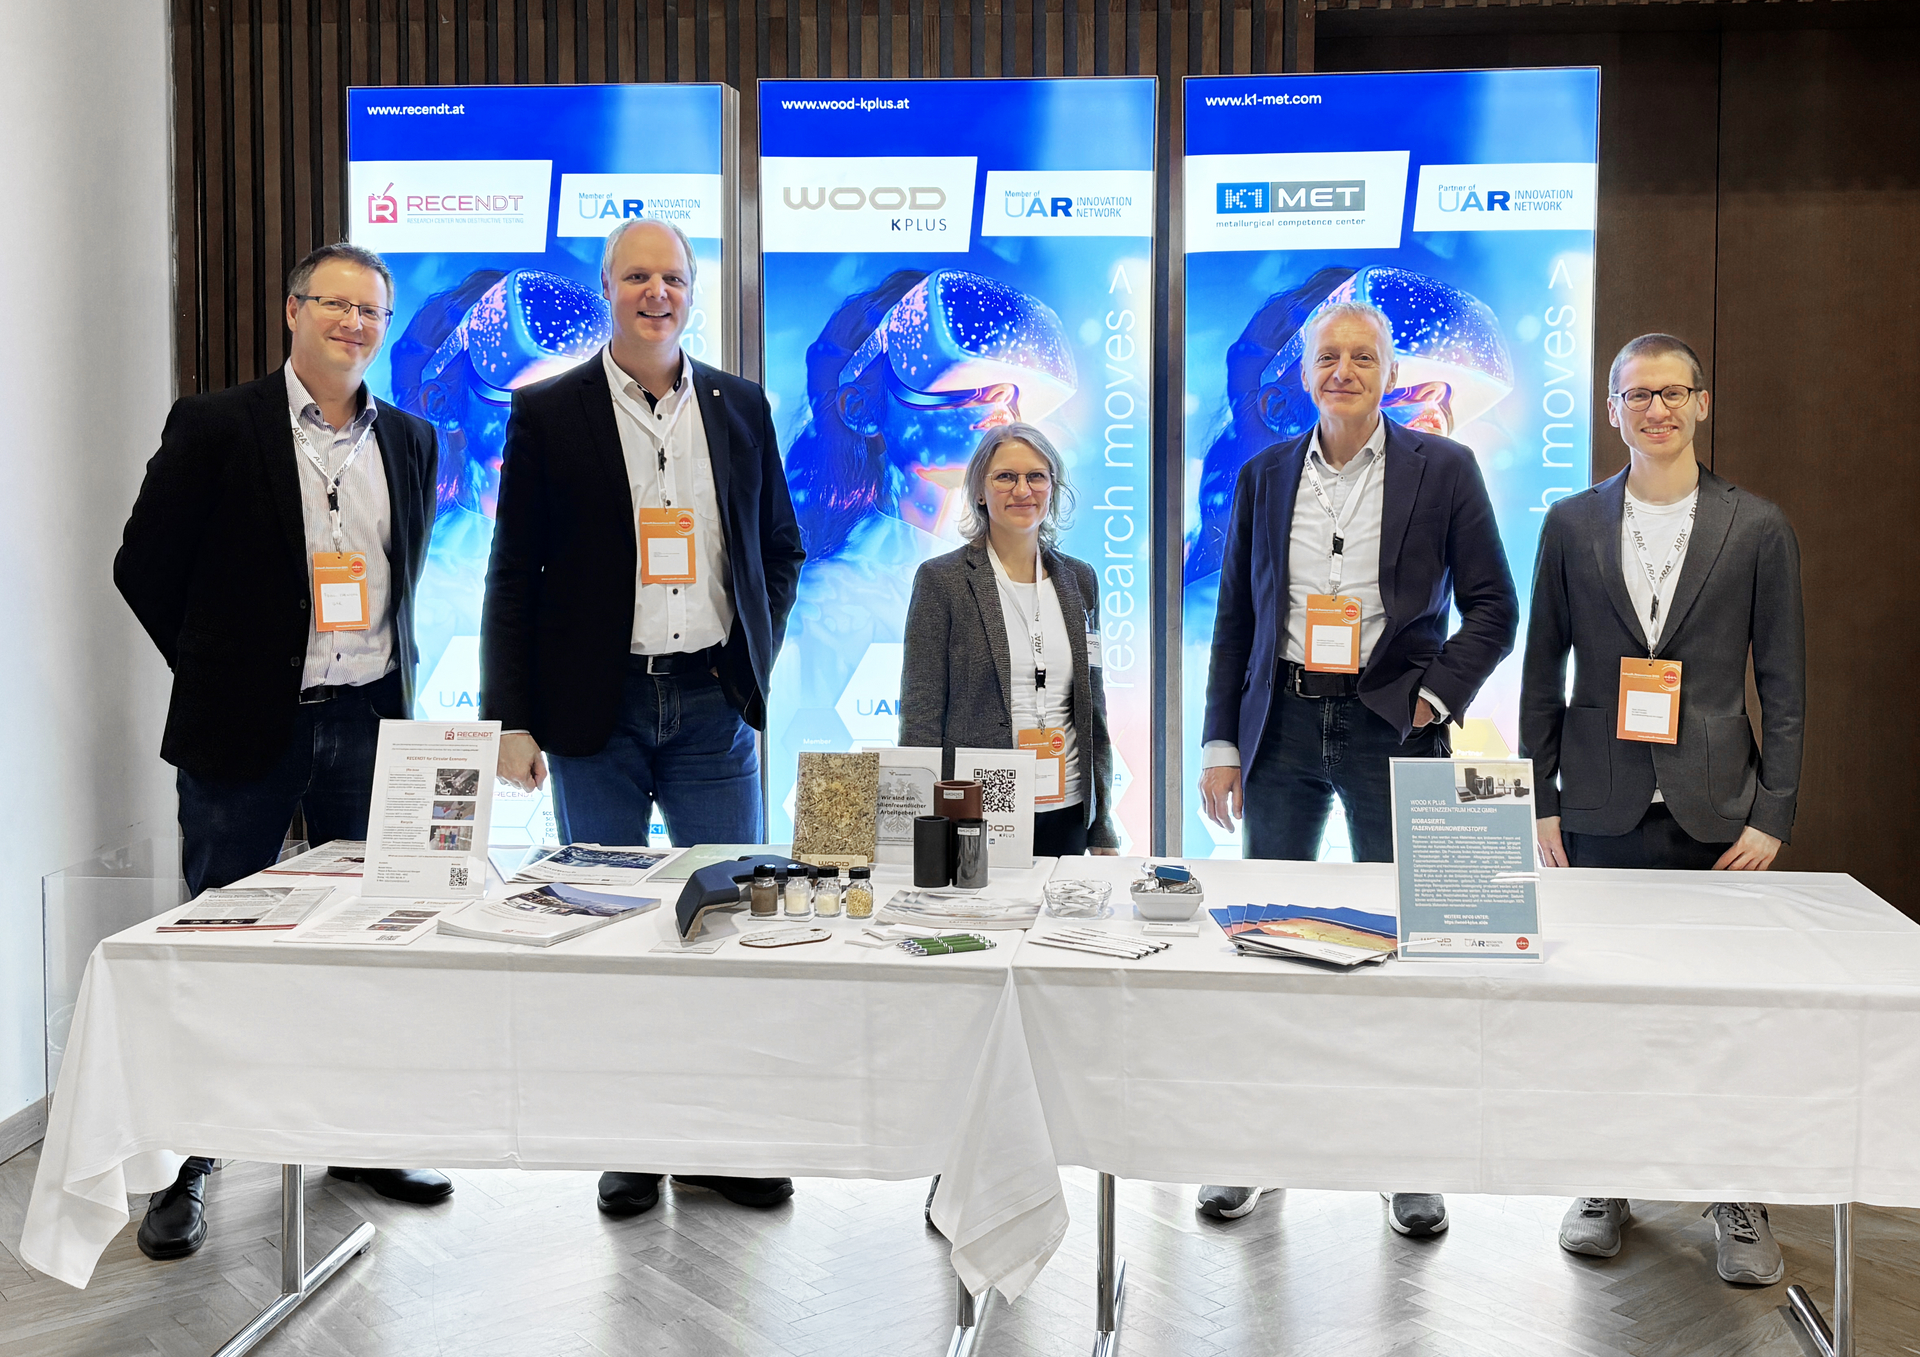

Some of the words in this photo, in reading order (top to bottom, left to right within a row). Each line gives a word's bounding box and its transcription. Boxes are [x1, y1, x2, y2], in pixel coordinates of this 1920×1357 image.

[781, 97, 910, 112] www.wood-kplus.at
[1205, 92, 1322, 107] www.k1-met.com
[367, 103, 465, 116] www.recendt.at
[783, 186, 947, 211] WOOD
[1076, 196, 1132, 206] INNOVATION
[1225, 188, 1263, 209] K1
[1278, 187, 1360, 208] MET
[1438, 190, 1510, 212] UAR
[1514, 190, 1573, 200] INNOVATION
[406, 195, 524, 212] RECENDT
[579, 199, 644, 219] UAR
[648, 199, 700, 208] INNOVATION
[1005, 197, 1073, 218] UAR
[1514, 201, 1562, 211] NETWORK
[648, 210, 691, 219] NETWORK
[1076, 208, 1122, 218] NETWORK
[1216, 219, 1275, 228] metallurgical
[1278, 218, 1332, 228] competence
[1103, 308, 1137, 469] moves
[1542, 304, 1577, 468] moves
[1093, 485, 1135, 689] research
